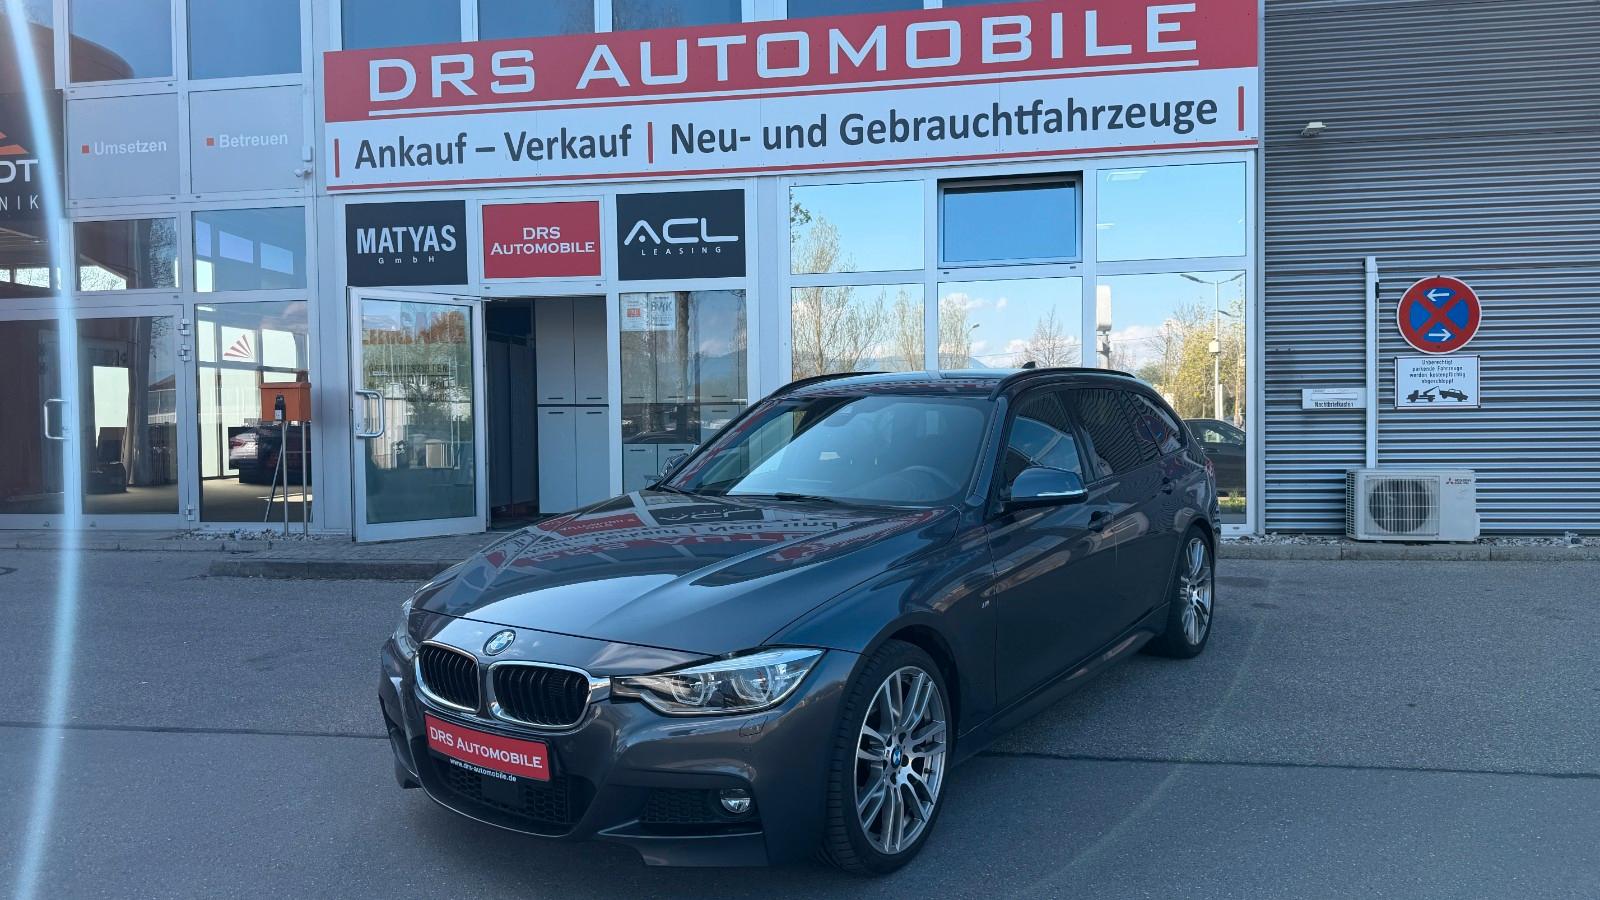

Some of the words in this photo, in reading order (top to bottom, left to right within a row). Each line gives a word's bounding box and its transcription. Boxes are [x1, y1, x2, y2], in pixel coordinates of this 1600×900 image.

[368, 49, 536, 102] DRS
[575, 2, 1197, 90] AUTOMOBILE
[218, 132, 289, 148] Betreuen
[354, 132, 468, 170] Ankauf
[503, 123, 633, 162] Verkauf
[671, 122, 751, 155] Neu-
[763, 113, 827, 150] und
[839, 97, 1218, 146] Gebrauchtfahrzeuge
[94, 139, 167, 156] Umsetzen
[356, 224, 457, 255] MATYAS
[522, 226, 561, 240] DRS
[623, 217, 739, 246] ACL
[490, 241, 596, 256] AUTOMOBILE
[641, 246, 721, 256] LEASING
[429, 726, 454, 747] DRS
[456, 737, 543, 769] AUTOMOBILE
[449, 758, 517, 782] www.drs-automobile.de
